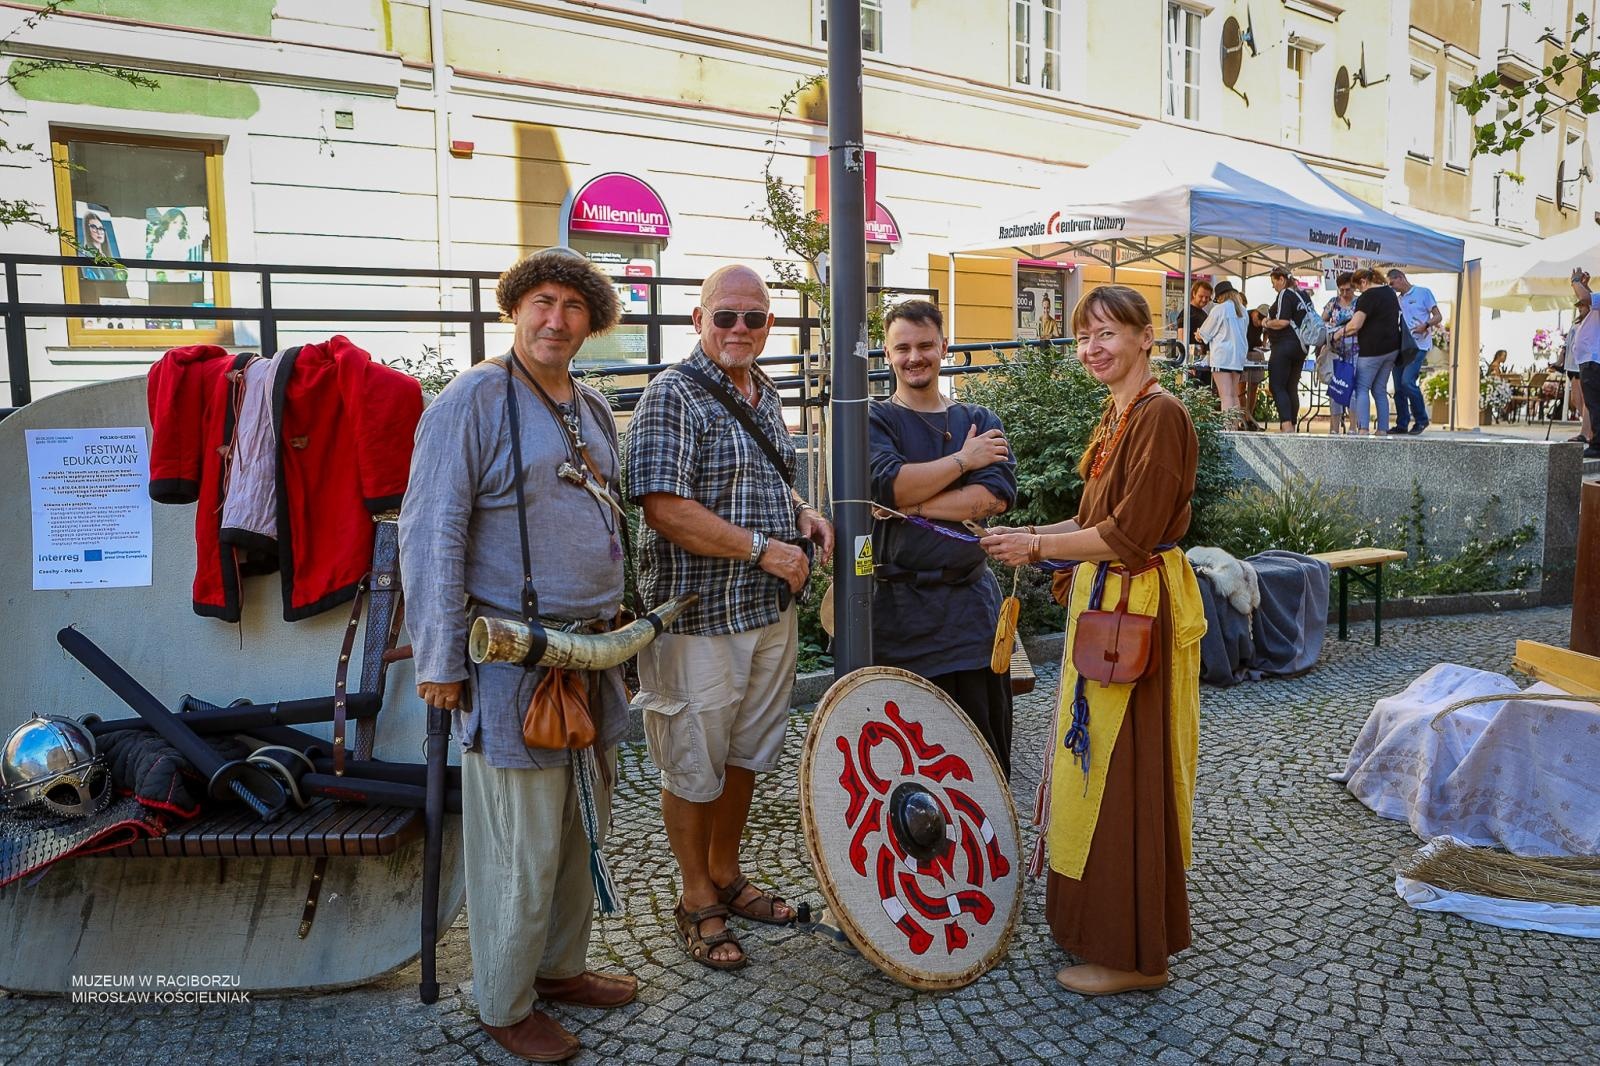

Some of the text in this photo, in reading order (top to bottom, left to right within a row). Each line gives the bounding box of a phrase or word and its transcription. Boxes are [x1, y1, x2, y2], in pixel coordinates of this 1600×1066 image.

[582, 201, 664, 225] Millennium
[638, 224, 656, 233] bank
[999, 222, 1045, 239] Raciborskie
[1093, 216, 1126, 231] Kultury
[1309, 227, 1338, 247] Raciborskie
[1364, 238, 1381, 254] Kultury
[85, 444, 138, 454] FESTIWAL
[63, 455, 138, 465] EDUKACYJNY
[38, 554, 79, 562] Interreg
